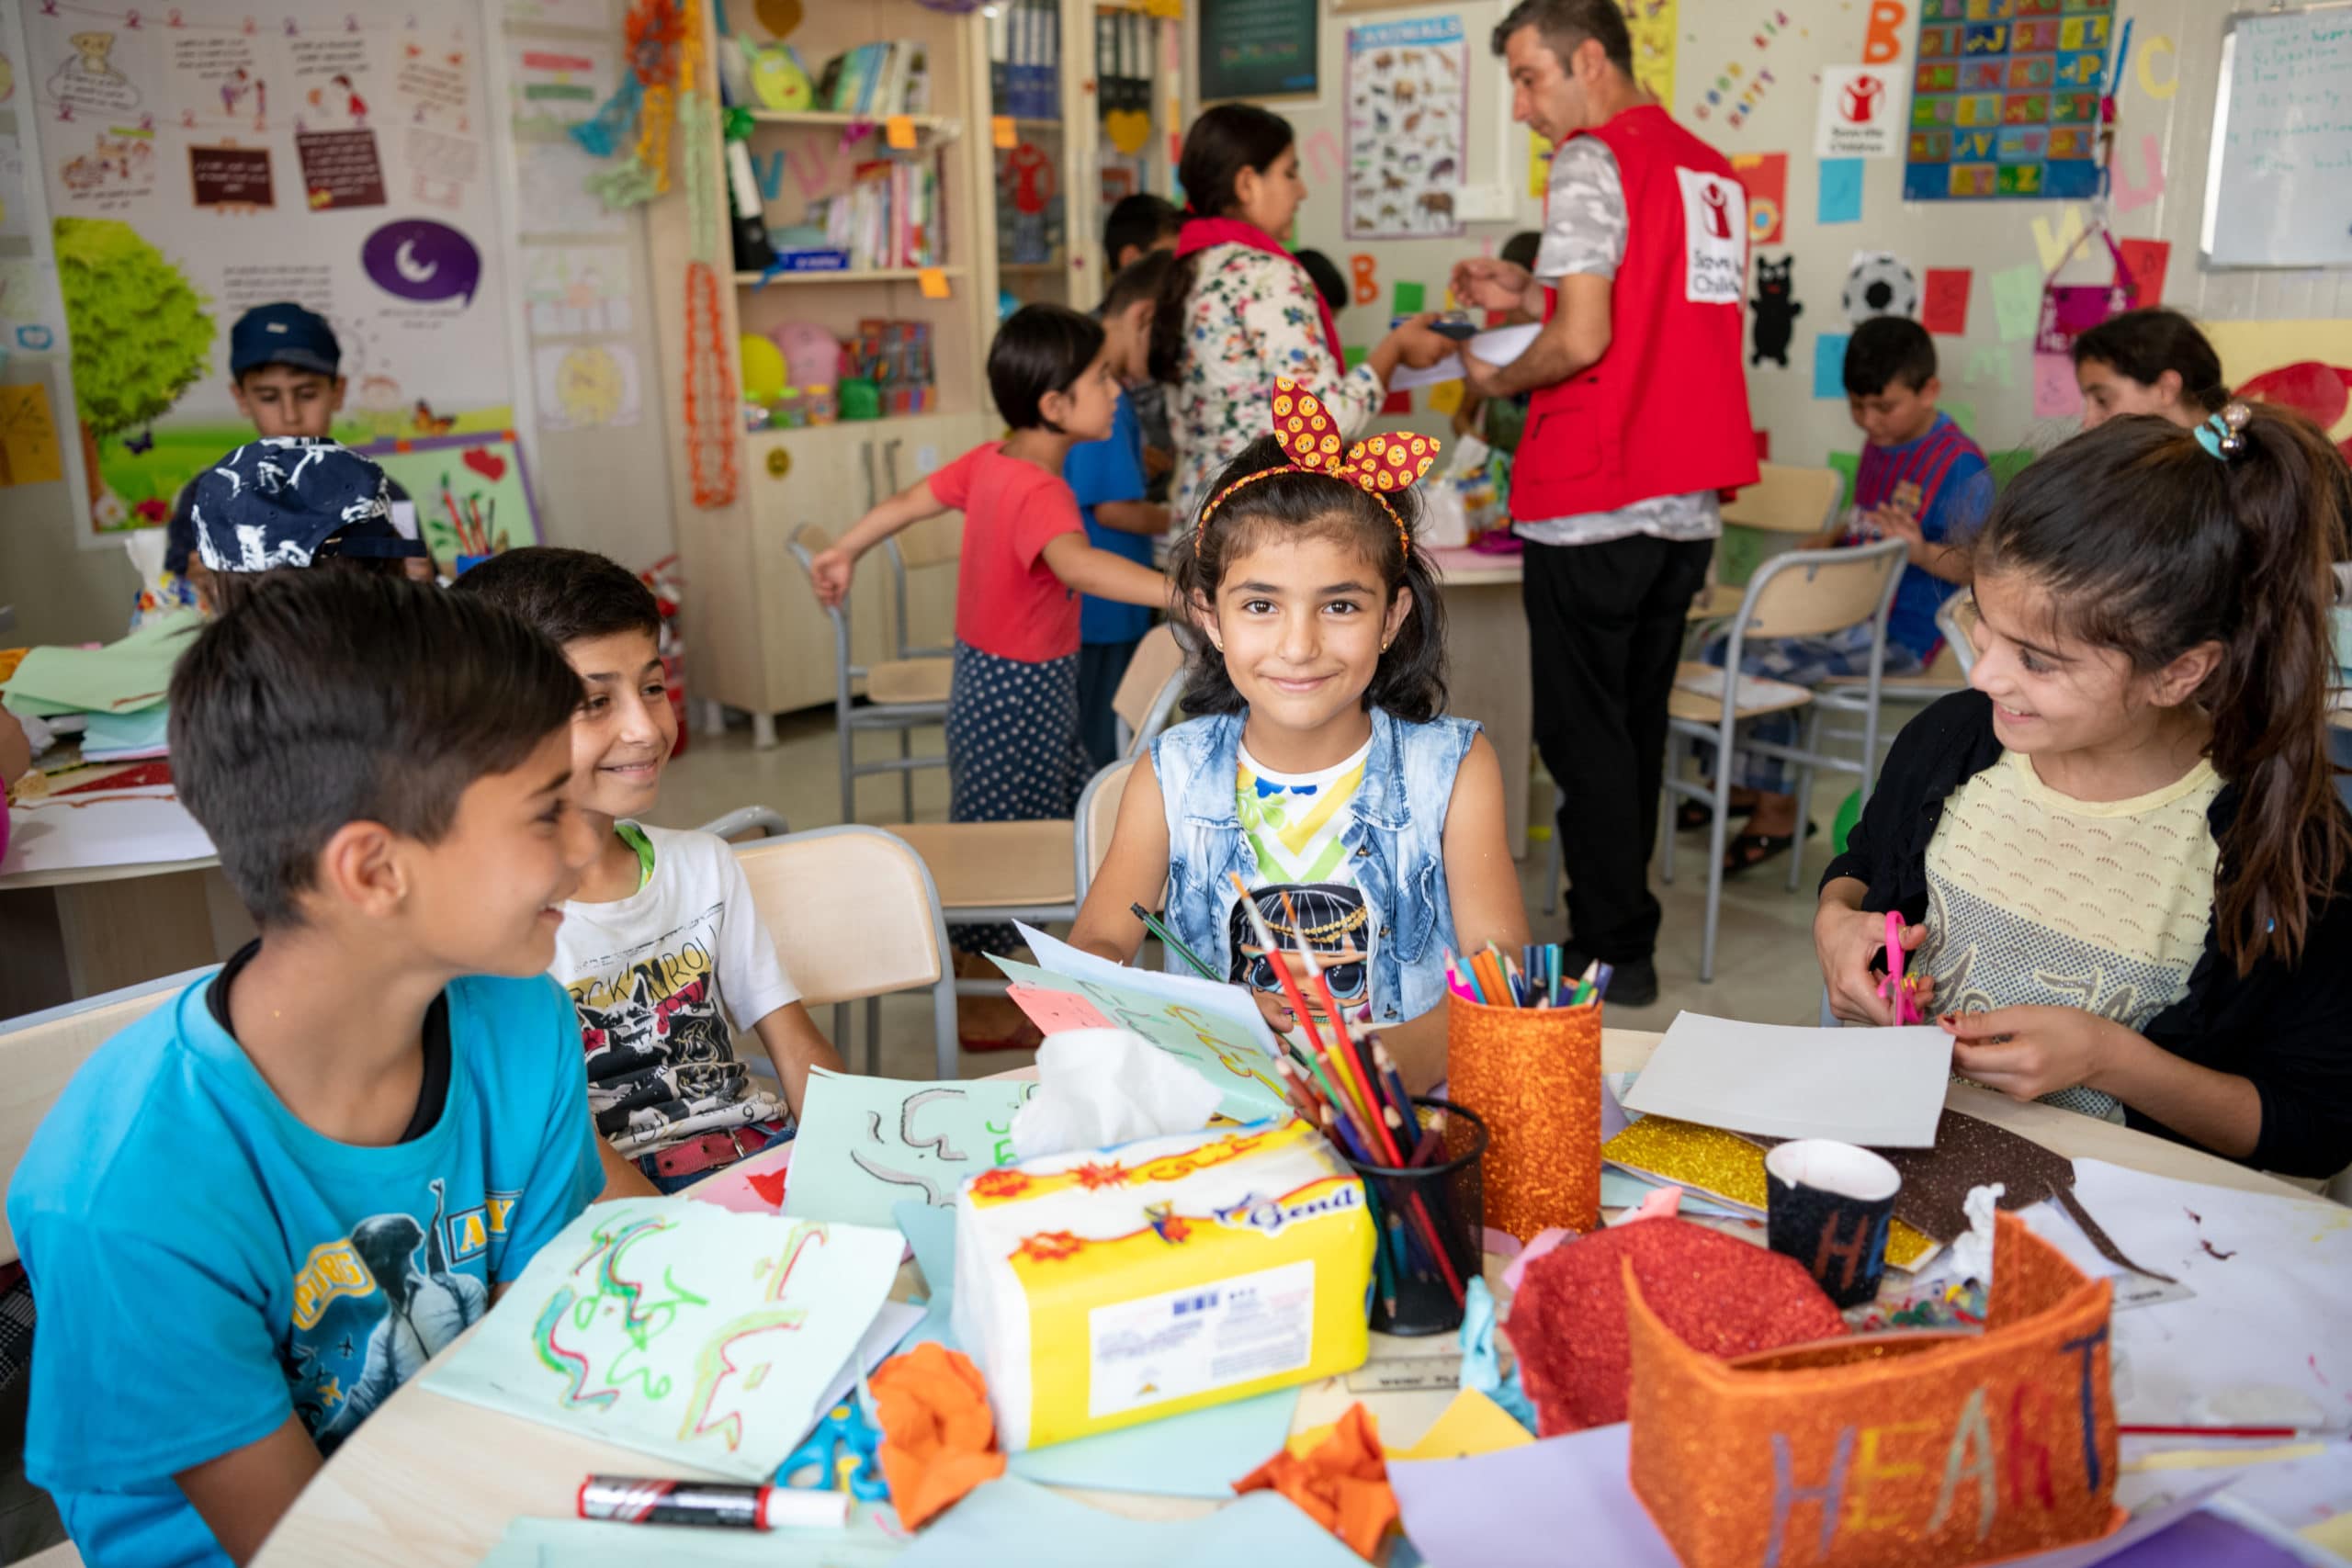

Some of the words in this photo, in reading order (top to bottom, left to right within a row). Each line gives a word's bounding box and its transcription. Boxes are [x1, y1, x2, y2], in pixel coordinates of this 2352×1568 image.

[1862, 0, 1906, 63] B
[2078, 54, 2100, 84] P
[2137, 34, 2178, 98] C
[1352, 254, 1379, 306] B
[294, 1251, 364, 1321] PUBG
[1762, 1325, 2108, 1568] HEART
